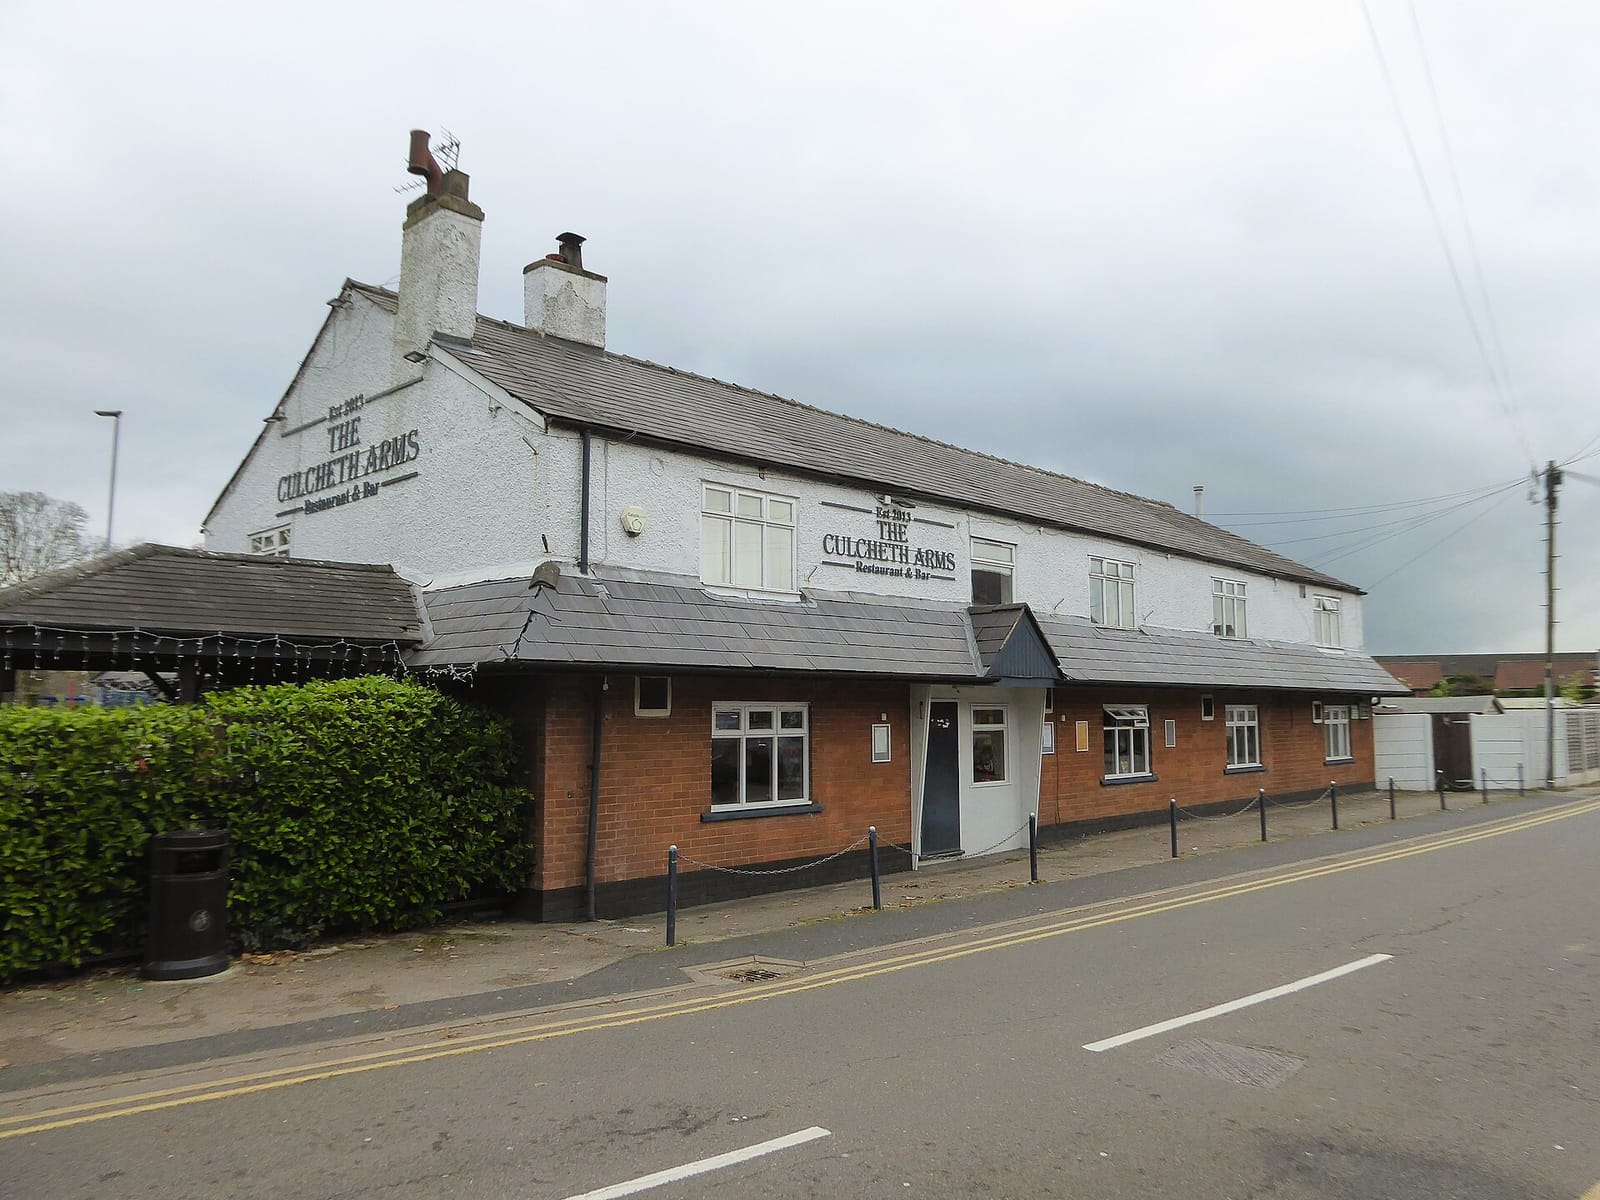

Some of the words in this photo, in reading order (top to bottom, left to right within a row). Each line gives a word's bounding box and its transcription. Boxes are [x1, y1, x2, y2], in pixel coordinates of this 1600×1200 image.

[327, 416, 361, 453] THE
[278, 450, 361, 503] CULCHETH
[365, 429, 419, 476] ARMS
[304, 488, 350, 515] Restaurant
[352, 484, 361, 501] &
[363, 481, 379, 498] Bar
[876, 506, 889, 519] Est
[892, 509, 911, 523] 2013
[876, 520, 908, 543] THE
[823, 533, 909, 564] CULCHETH
[914, 548, 956, 571] ARMS
[856, 561, 903, 577] Restaurant
[905, 567, 913, 579] &
[915, 568, 930, 580] Bar
